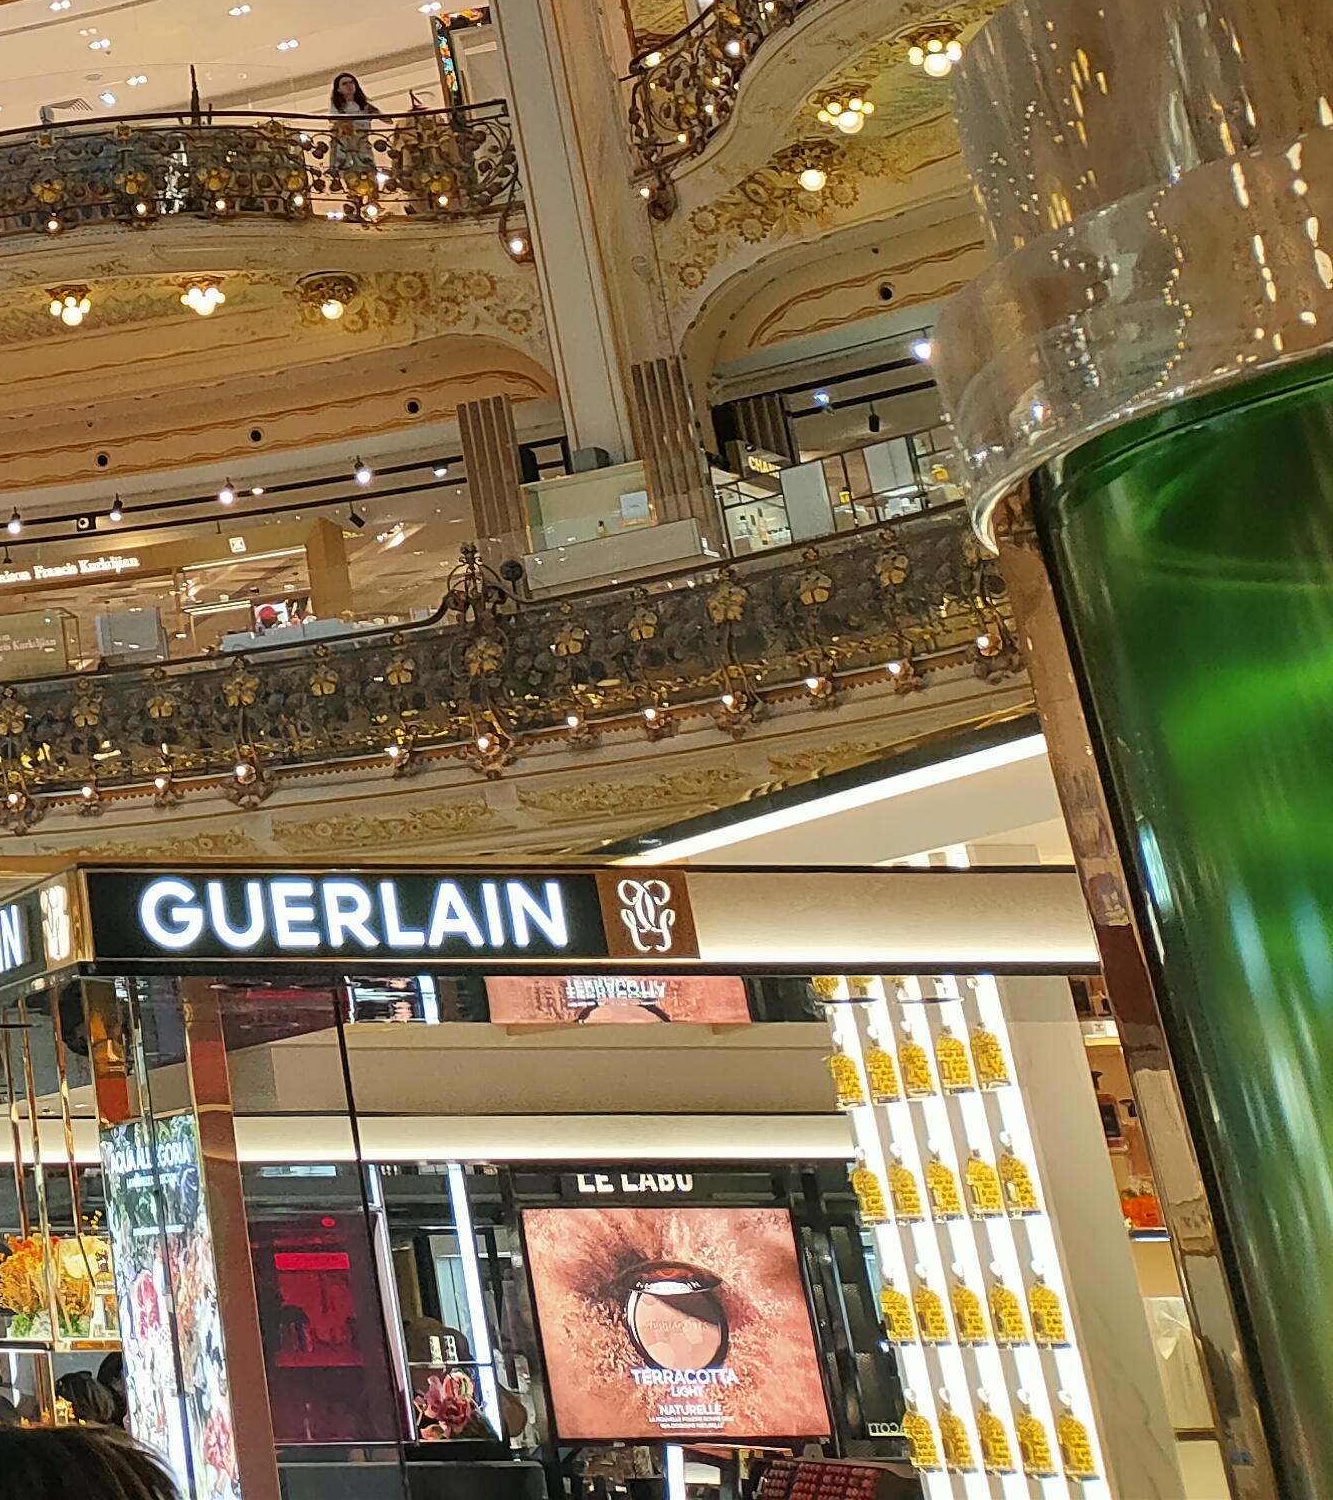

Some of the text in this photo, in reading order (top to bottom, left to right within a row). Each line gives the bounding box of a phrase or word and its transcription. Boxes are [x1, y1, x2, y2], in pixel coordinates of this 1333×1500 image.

[33, 562, 78, 579] Francis
[139, 877, 570, 950] GUERLAIN
[630, 1368, 740, 1385] TERRACOTTA
[670, 1385, 705, 1398] LIGHT
[658, 1403, 723, 1416] NATURELLE
